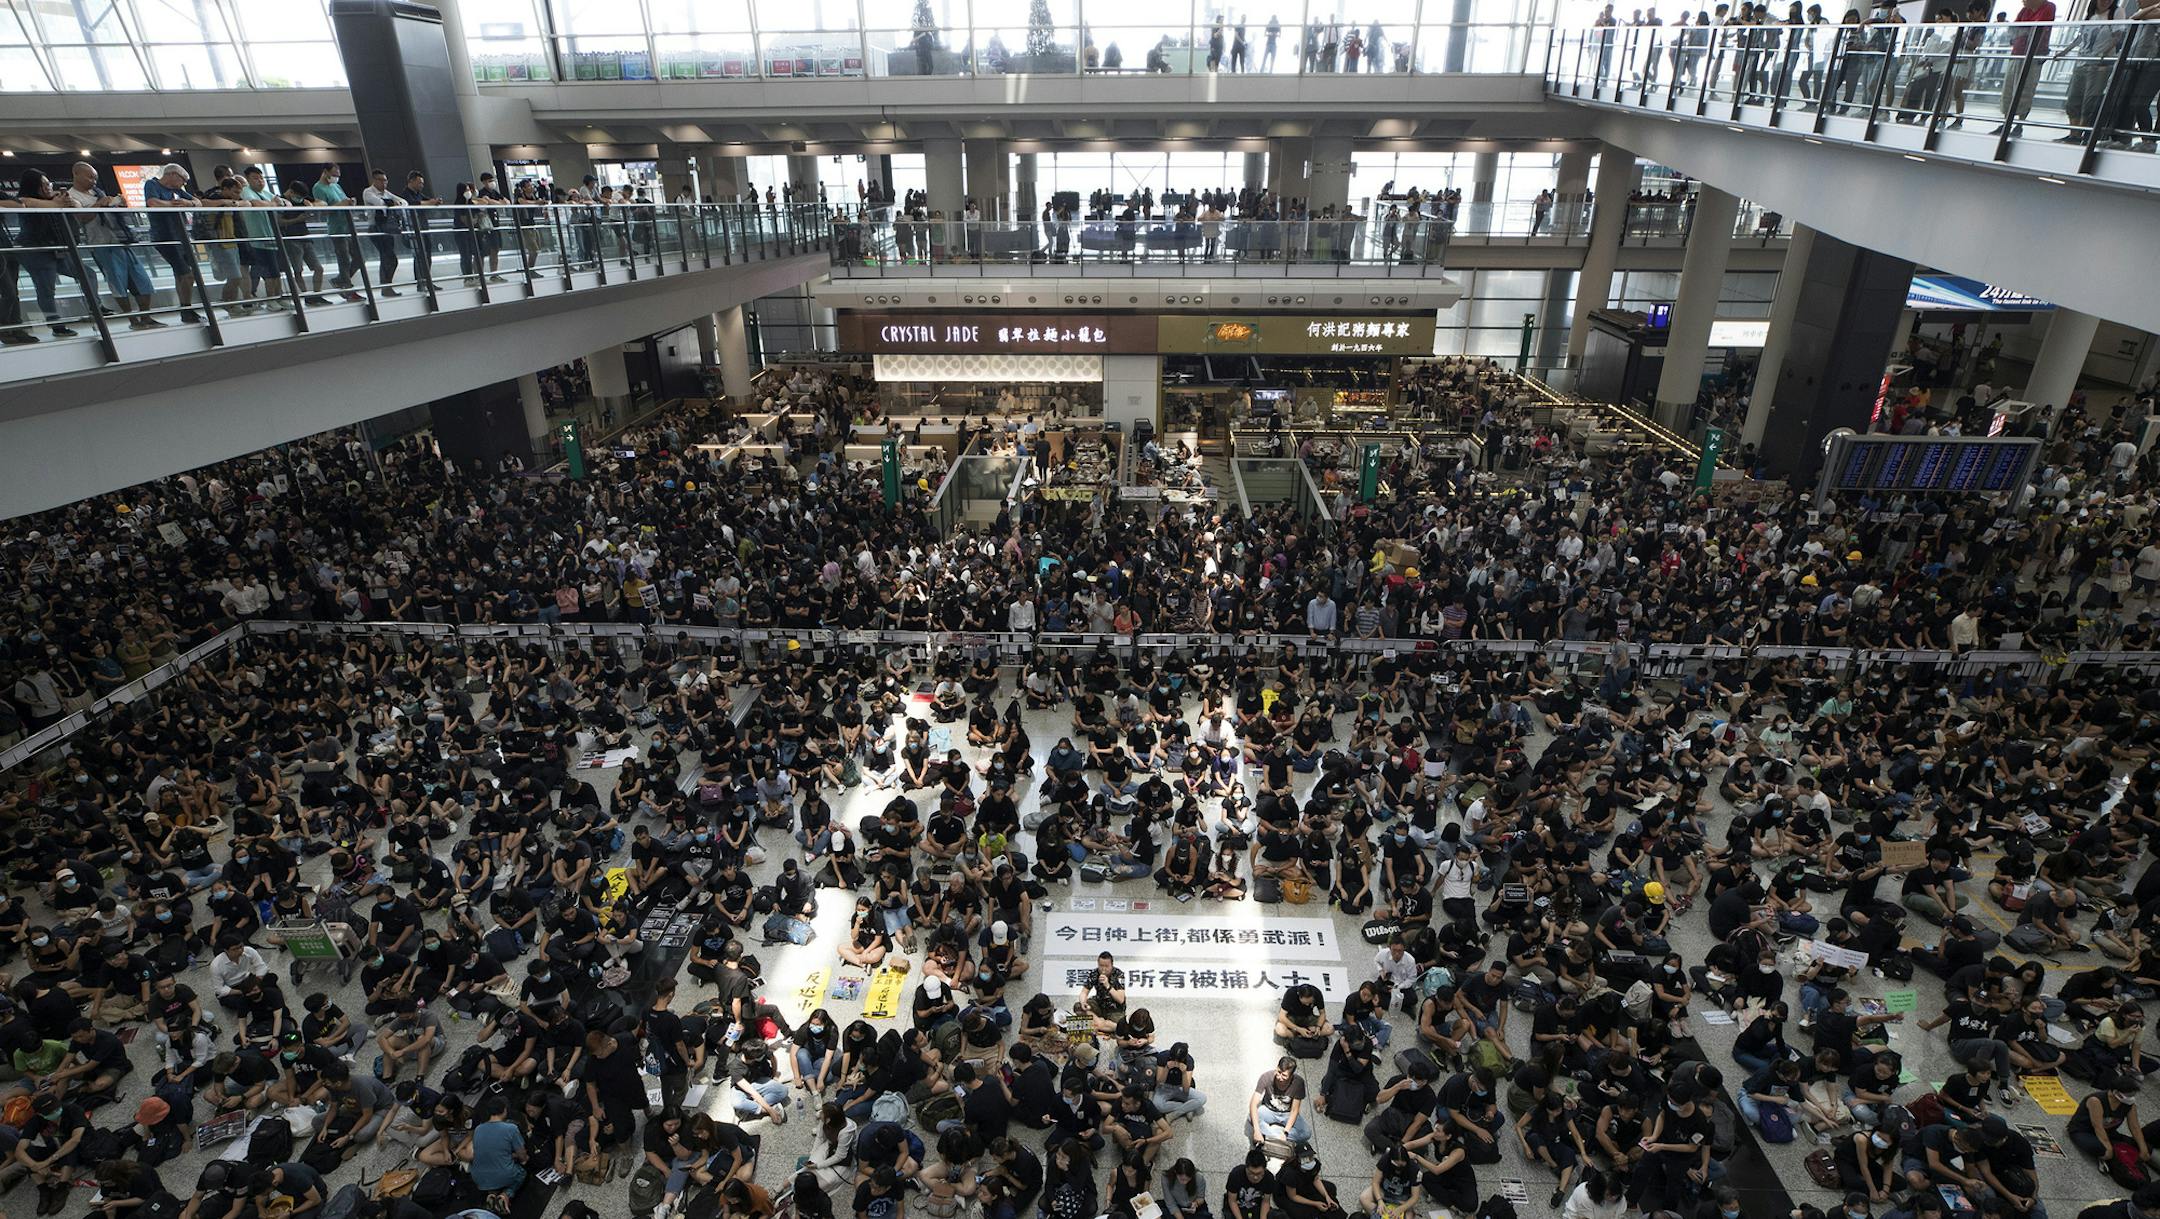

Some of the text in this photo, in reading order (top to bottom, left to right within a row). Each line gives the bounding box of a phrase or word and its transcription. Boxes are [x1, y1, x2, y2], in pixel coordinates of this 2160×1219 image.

[881, 325, 980, 343] CRYSTAL JADE
[1306, 321, 1410, 338] 何洪記粥麵專家
[1364, 925, 1401, 938] Wilson
[1065, 969, 1332, 992] 釋所有被捕人士！
